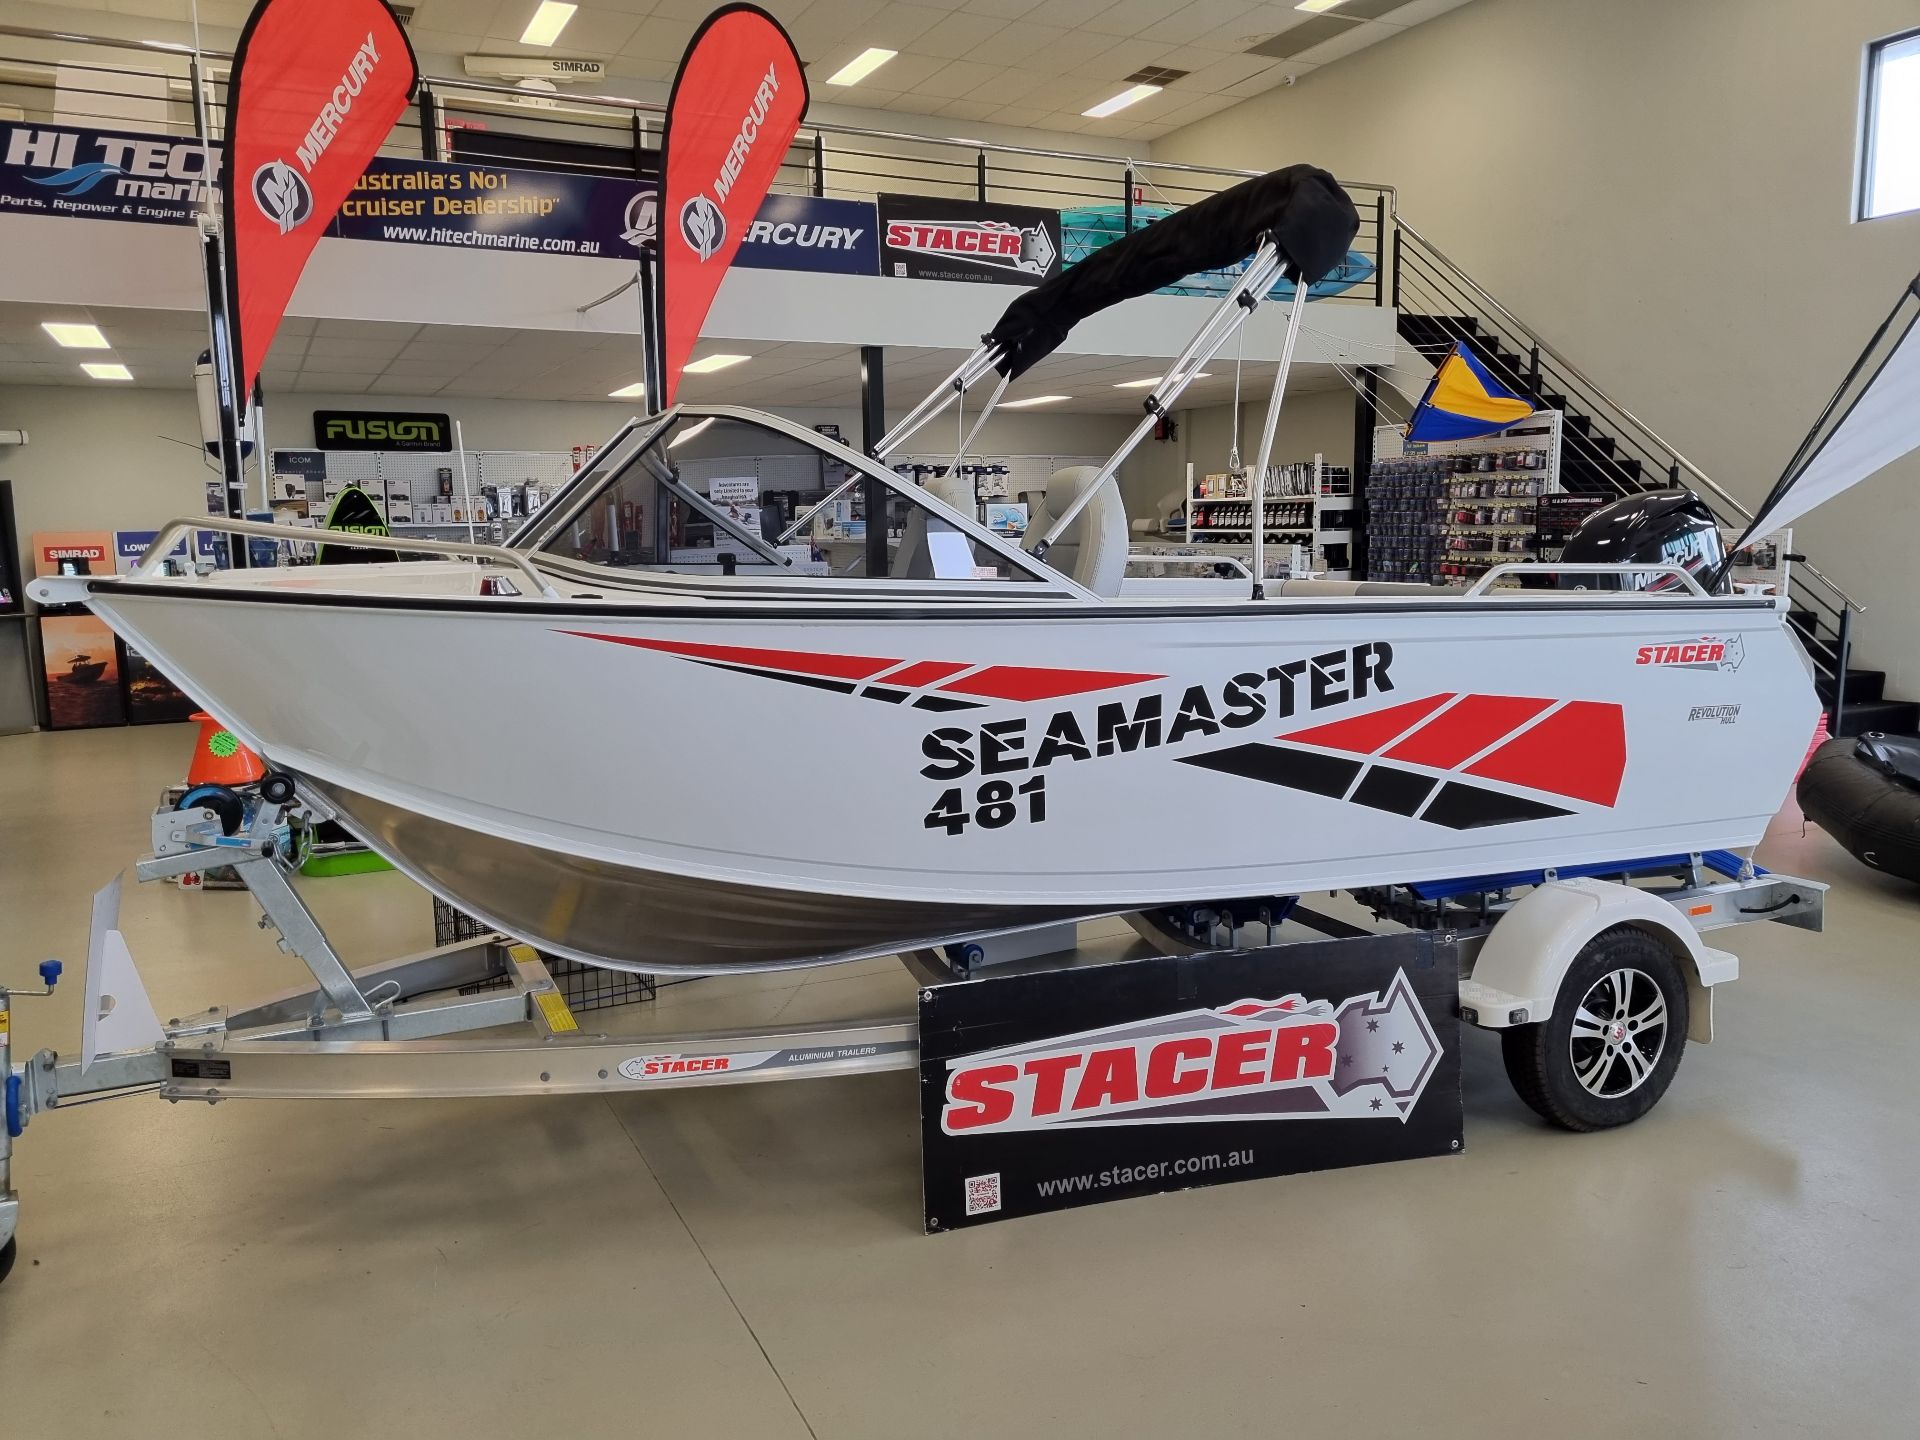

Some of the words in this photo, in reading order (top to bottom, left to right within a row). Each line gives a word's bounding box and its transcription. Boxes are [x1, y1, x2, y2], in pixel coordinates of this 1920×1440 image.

[552, 61, 600, 73] SIMRAD
[296, 32, 380, 173] MERCURY
[713, 61, 779, 203] MERCURY
[4, 128, 80, 169] HI
[115, 178, 224, 204] marin
[352, 171, 462, 191] ustralia's
[469, 171, 507, 190] No1
[53, 199, 119, 213] Repower
[122, 204, 133, 215] &
[137, 206, 186, 219] Engine
[342, 196, 425, 217] cruiser
[383, 225, 600, 254] www.hitechmarine.com.au
[742, 220, 864, 250] RCURY
[887, 224, 1022, 255] STACER
[918, 269, 993, 282] www.stacer.com.au
[49, 549, 100, 559] SIMRAD
[124, 544, 181, 552] LOWE
[1635, 644, 1725, 665] STACER
[919, 640, 1395, 781] SEAMASTER
[1687, 704, 1741, 721] REVOLUTION
[1720, 716, 1736, 724] HULL
[922, 774, 1047, 837] 481
[644, 1058, 729, 1075] STACER
[788, 1051, 834, 1062] ALUMINIUM
[837, 1046, 877, 1058] TRAILERS
[945, 1022, 1340, 1132] STACER
[1036, 1148, 1255, 1199] www.stacer.com.au
